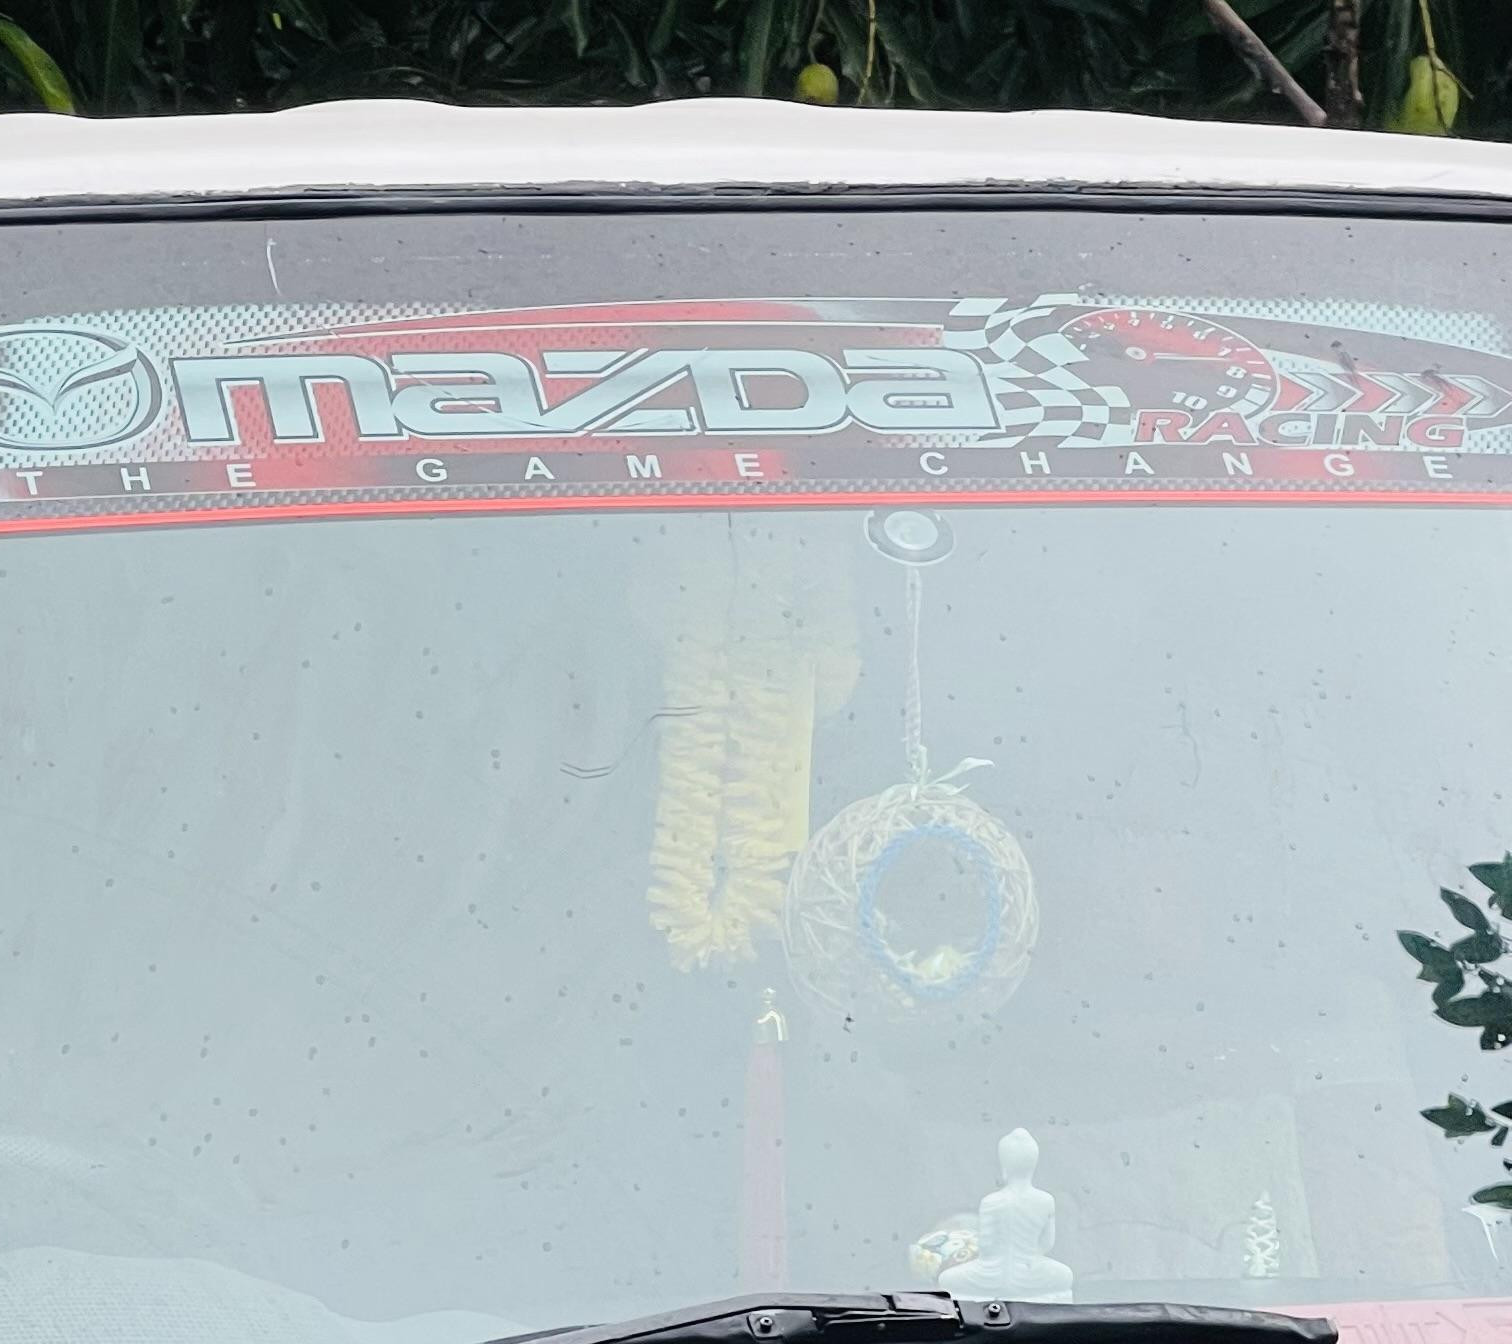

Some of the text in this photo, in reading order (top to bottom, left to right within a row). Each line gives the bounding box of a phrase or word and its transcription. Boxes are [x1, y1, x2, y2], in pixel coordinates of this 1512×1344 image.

[1225, 365, 1247, 379] 8
[1170, 391, 1209, 410] 10
[1216, 385, 1238, 398] 9
[1134, 410, 1466, 448] RACING
[17, 452, 1454, 495] THE GAME CHANGE
